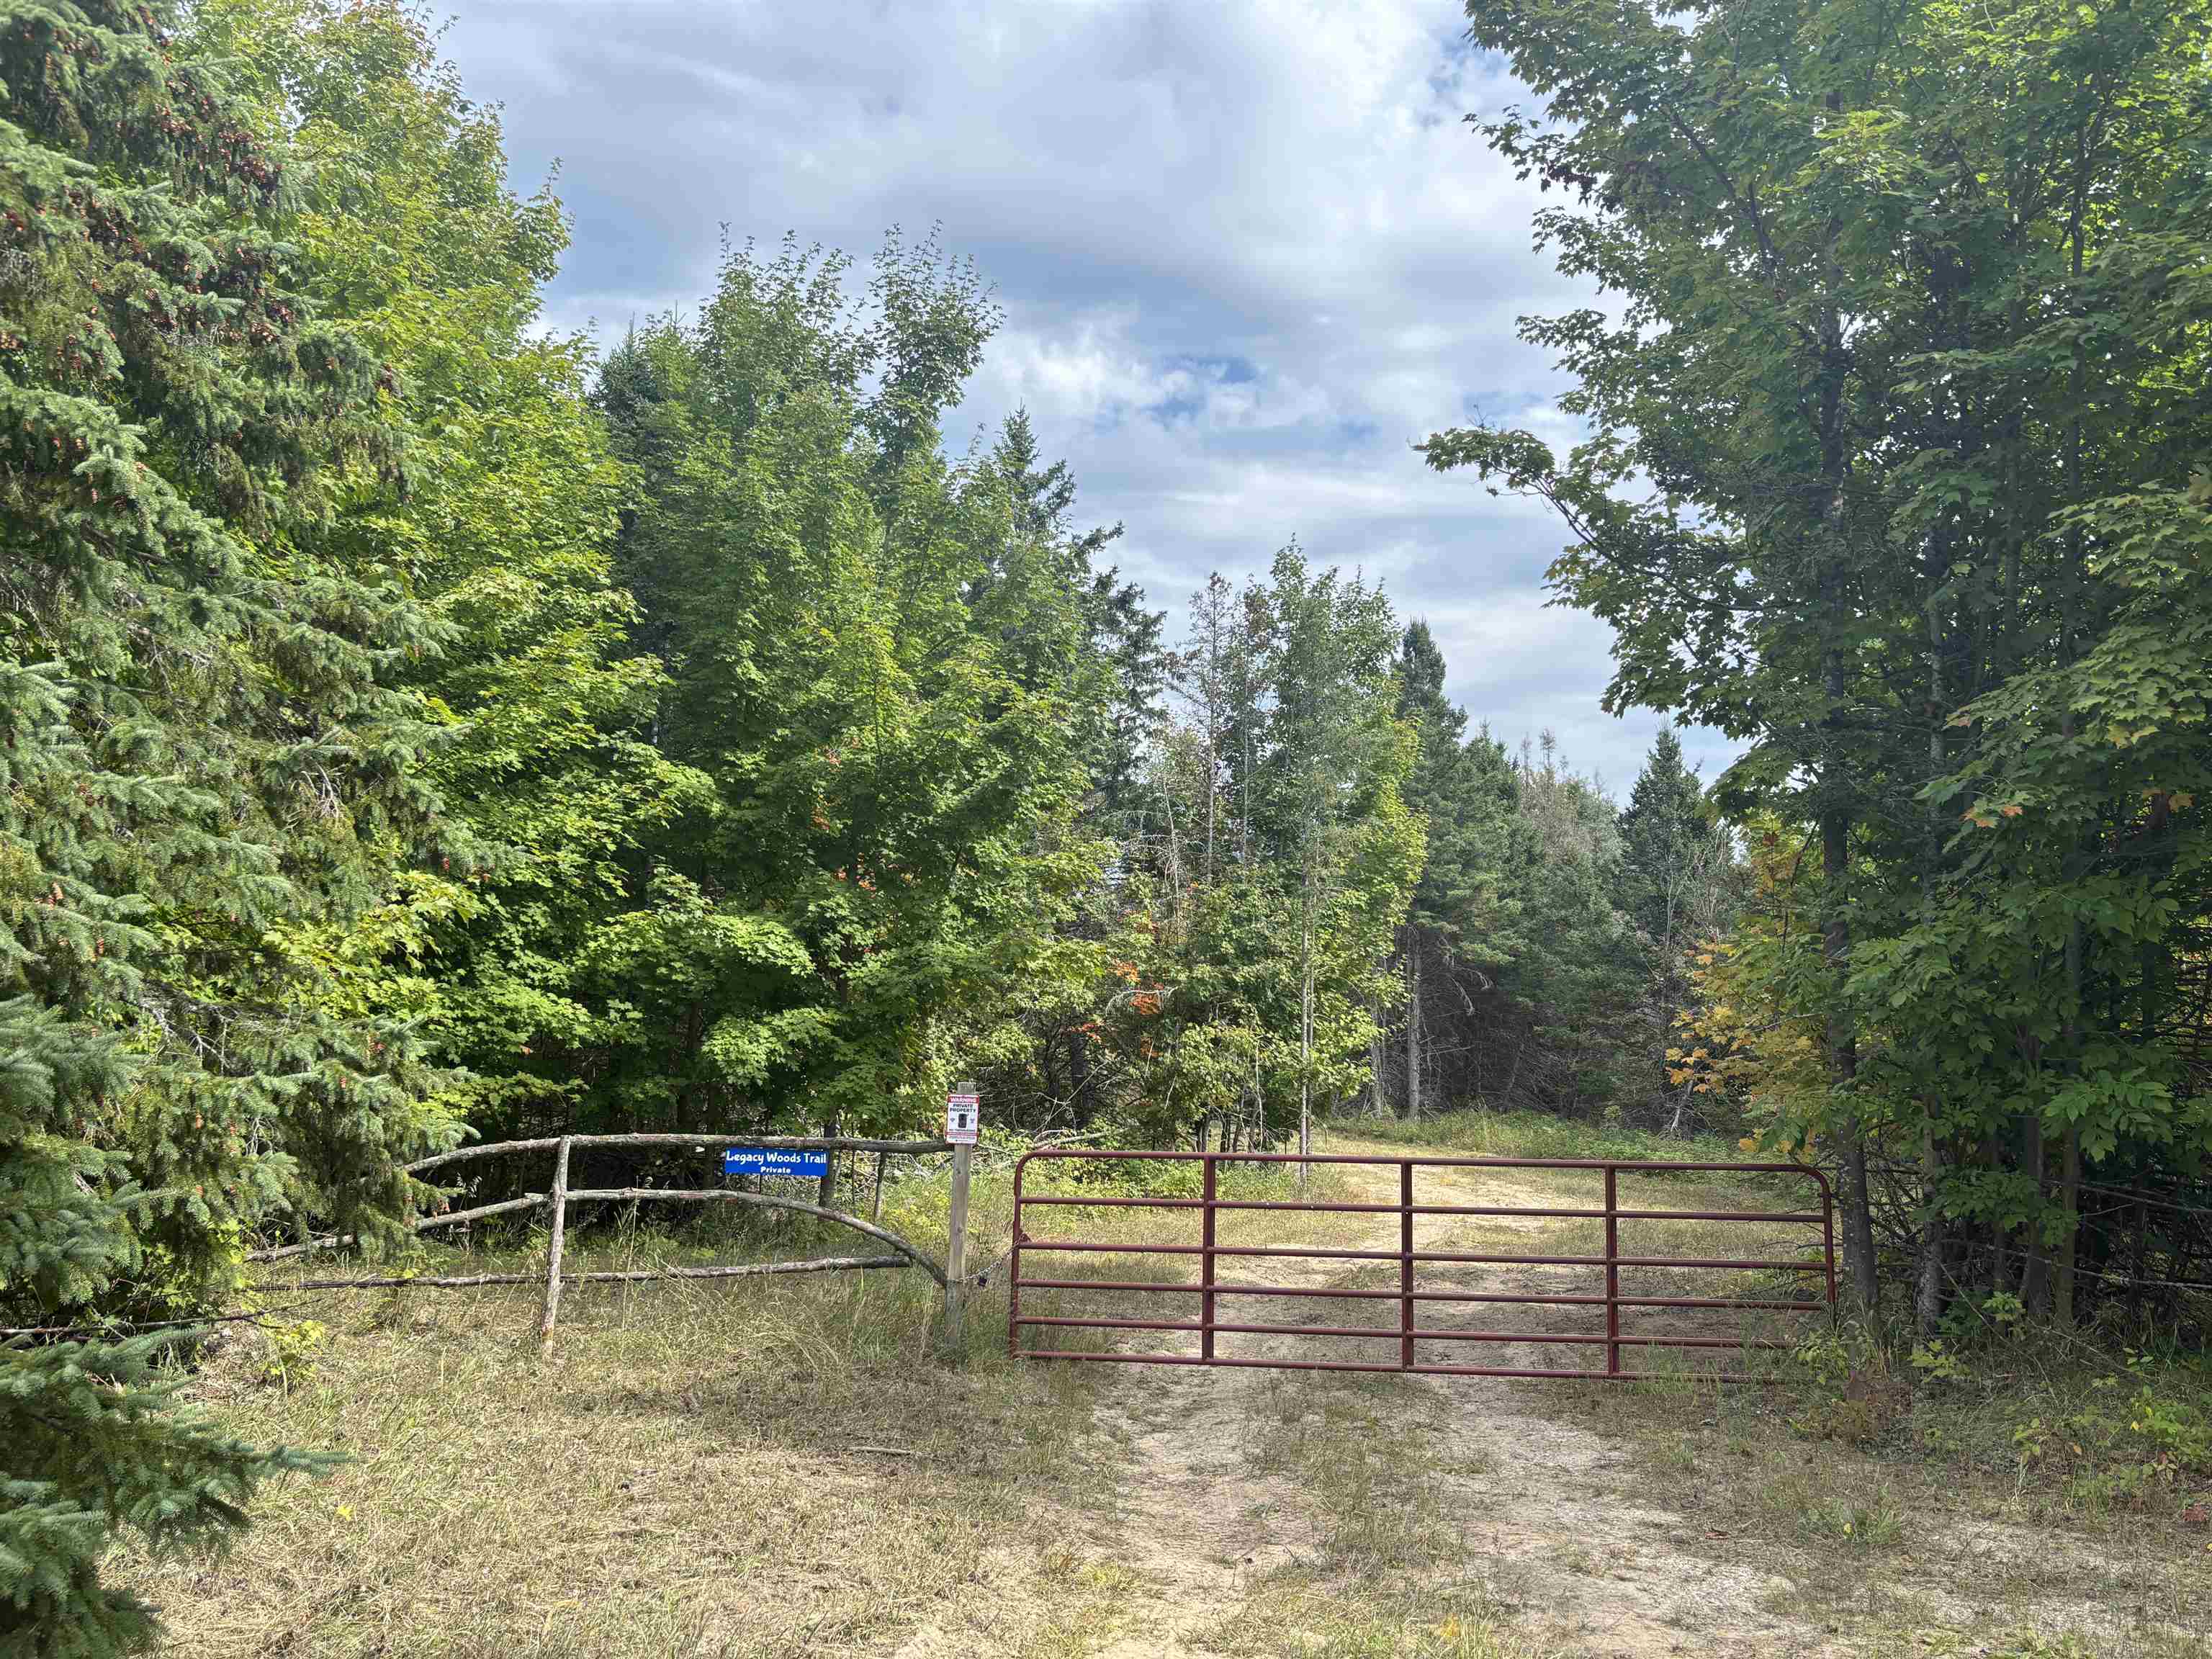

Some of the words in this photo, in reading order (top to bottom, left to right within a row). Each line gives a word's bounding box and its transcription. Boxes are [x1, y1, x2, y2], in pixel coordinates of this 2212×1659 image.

[727, 1151, 764, 1164] Legacy
[766, 1152, 801, 1163] Woods
[803, 1153, 827, 1164] Trail
